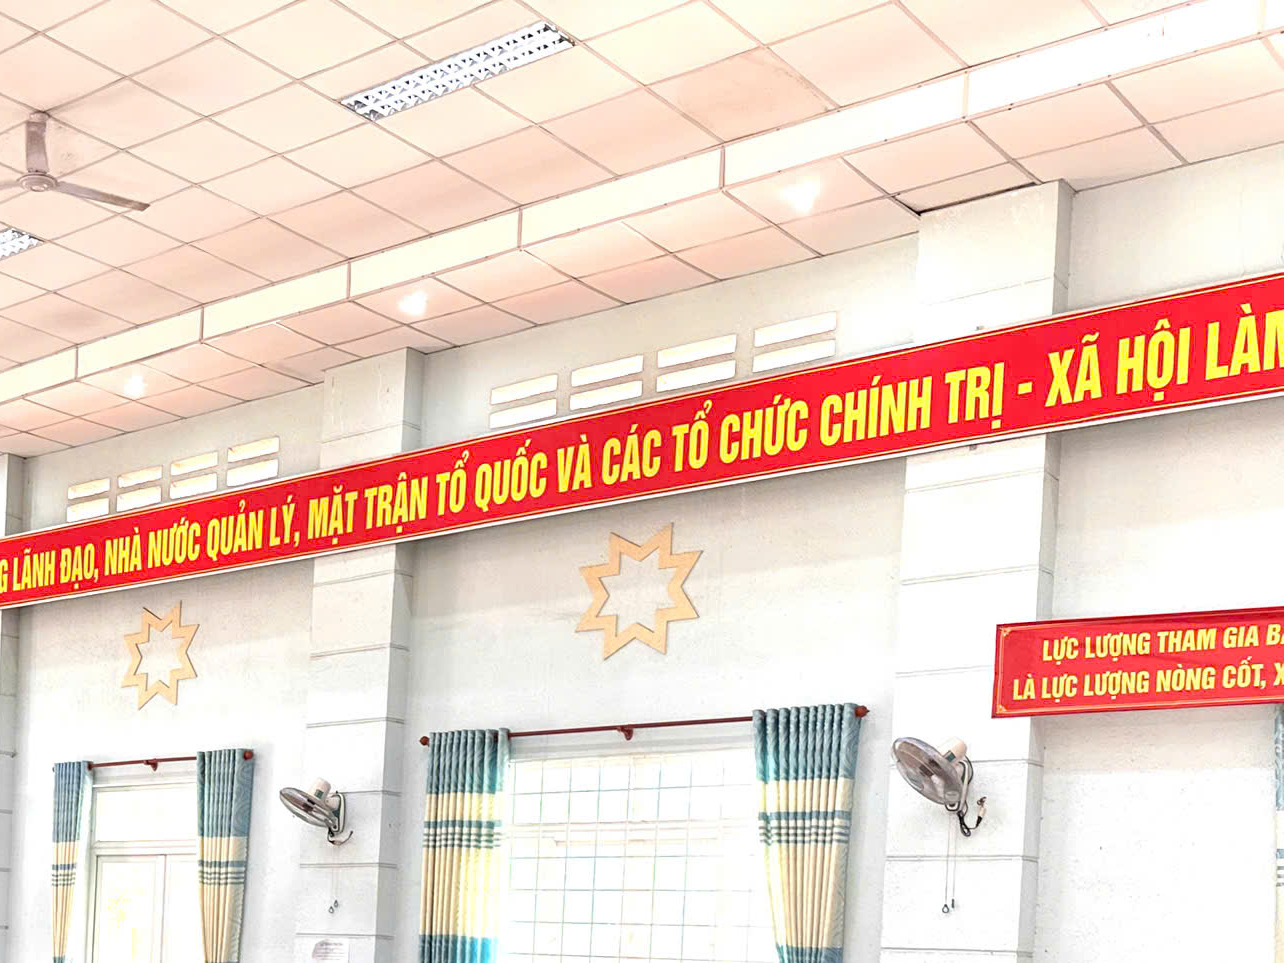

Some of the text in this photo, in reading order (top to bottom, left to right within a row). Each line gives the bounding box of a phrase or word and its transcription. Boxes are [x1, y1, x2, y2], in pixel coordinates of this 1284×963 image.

[12, 546, 56, 591] LÃNH
[59, 543, 100, 590] ĐẠO,
[105, 528, 142, 576] NHÀ
[148, 517, 200, 568] NƯỚC
[206, 499, 263, 562] QUẢN
[269, 496, 300, 547] LÝ,
[307, 484, 359, 545] MẶT
[364, 471, 428, 535] TRẬN
[435, 449, 470, 513] TỔ
[474, 437, 549, 513] QUỐC
[557, 434, 592, 492] VÀ
[602, 424, 661, 484] CÁC
[672, 400, 714, 470] TỔ
[719, 394, 809, 465] CHỨC
[818, 374, 934, 447] CHÍNH
[945, 361, 1006, 430] TRỊ
[1018, 382, 1032, 394] -
[1045, 333, 1102, 407] XÃ
[1115, 317, 1192, 402] HỘI
[1043, 624, 1284, 665] LỰC LƯỢNG THAM GIA B
[1013, 674, 1036, 700] LÀ
[1041, 674, 1078, 702] LỰC
[1084, 671, 1149, 699] LƯỢNG
[1156, 664, 1216, 692] NÒNG
[1222, 656, 1266, 688] CỐT,
